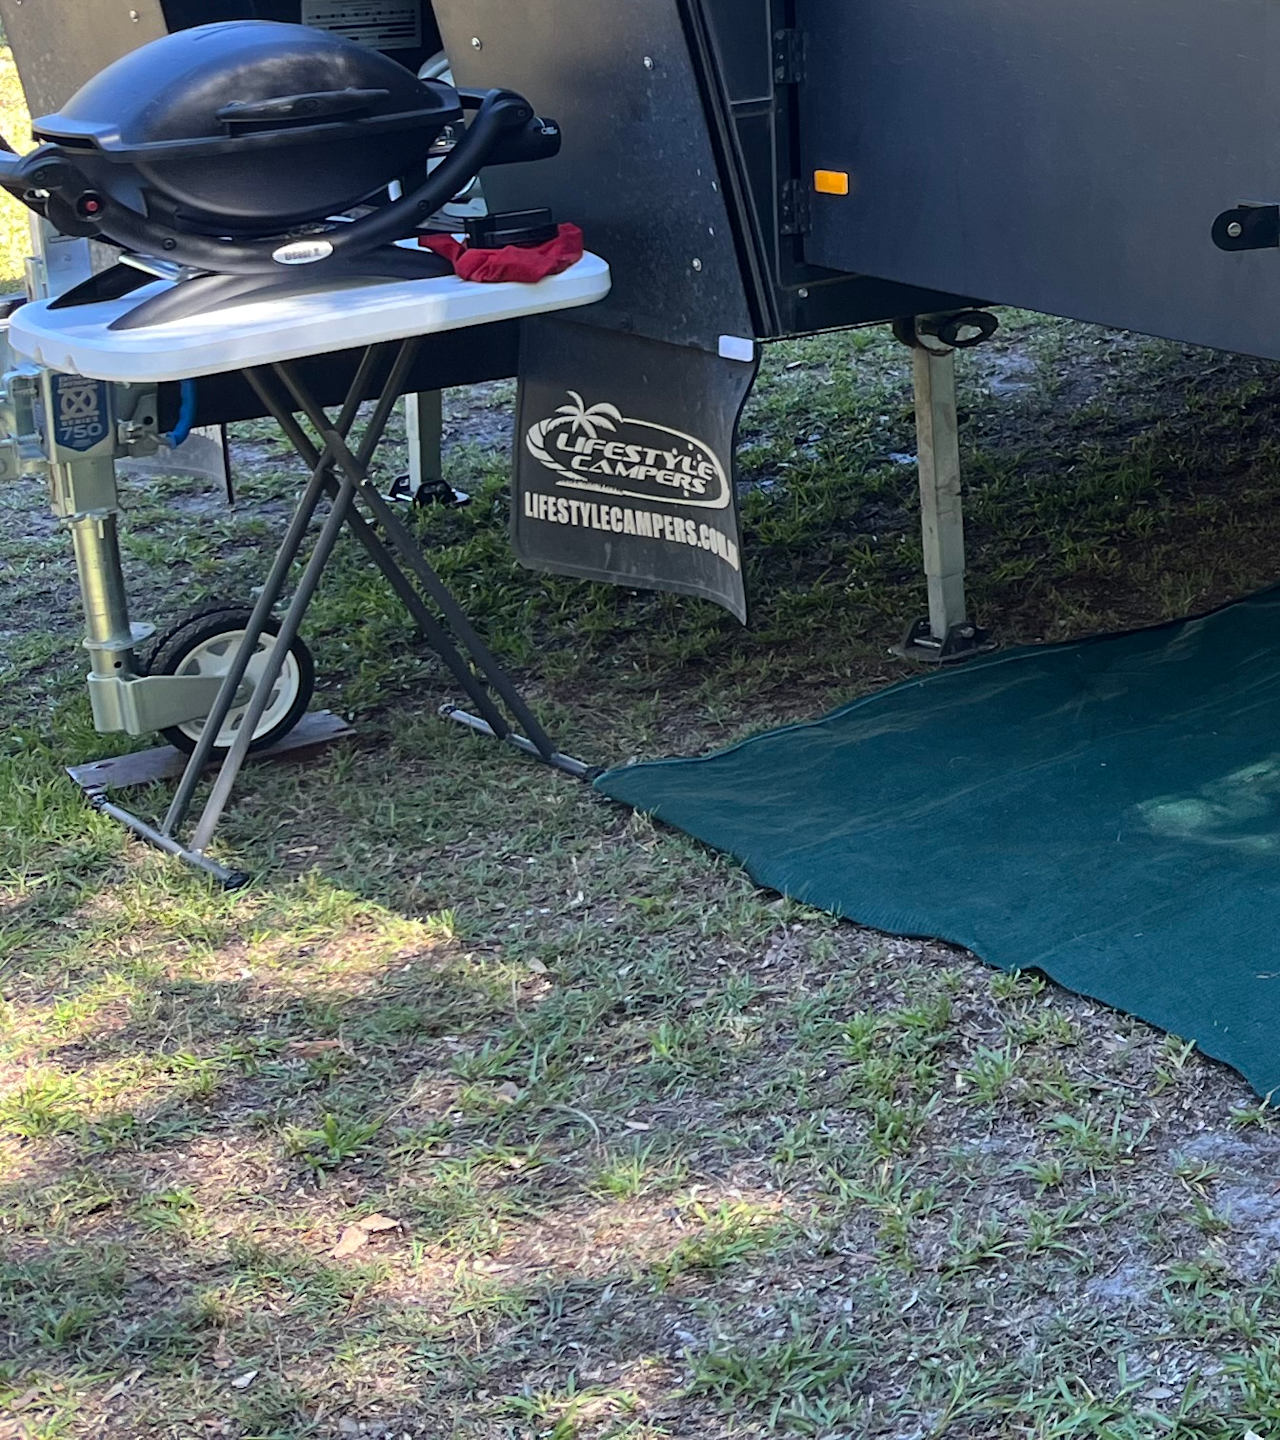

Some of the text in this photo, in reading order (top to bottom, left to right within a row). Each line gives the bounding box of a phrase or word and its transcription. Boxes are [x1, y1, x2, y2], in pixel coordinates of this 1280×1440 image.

[60, 422, 103, 440] 750
[556, 432, 716, 481] LIFESTYLE
[571, 455, 707, 495] CAMPERS
